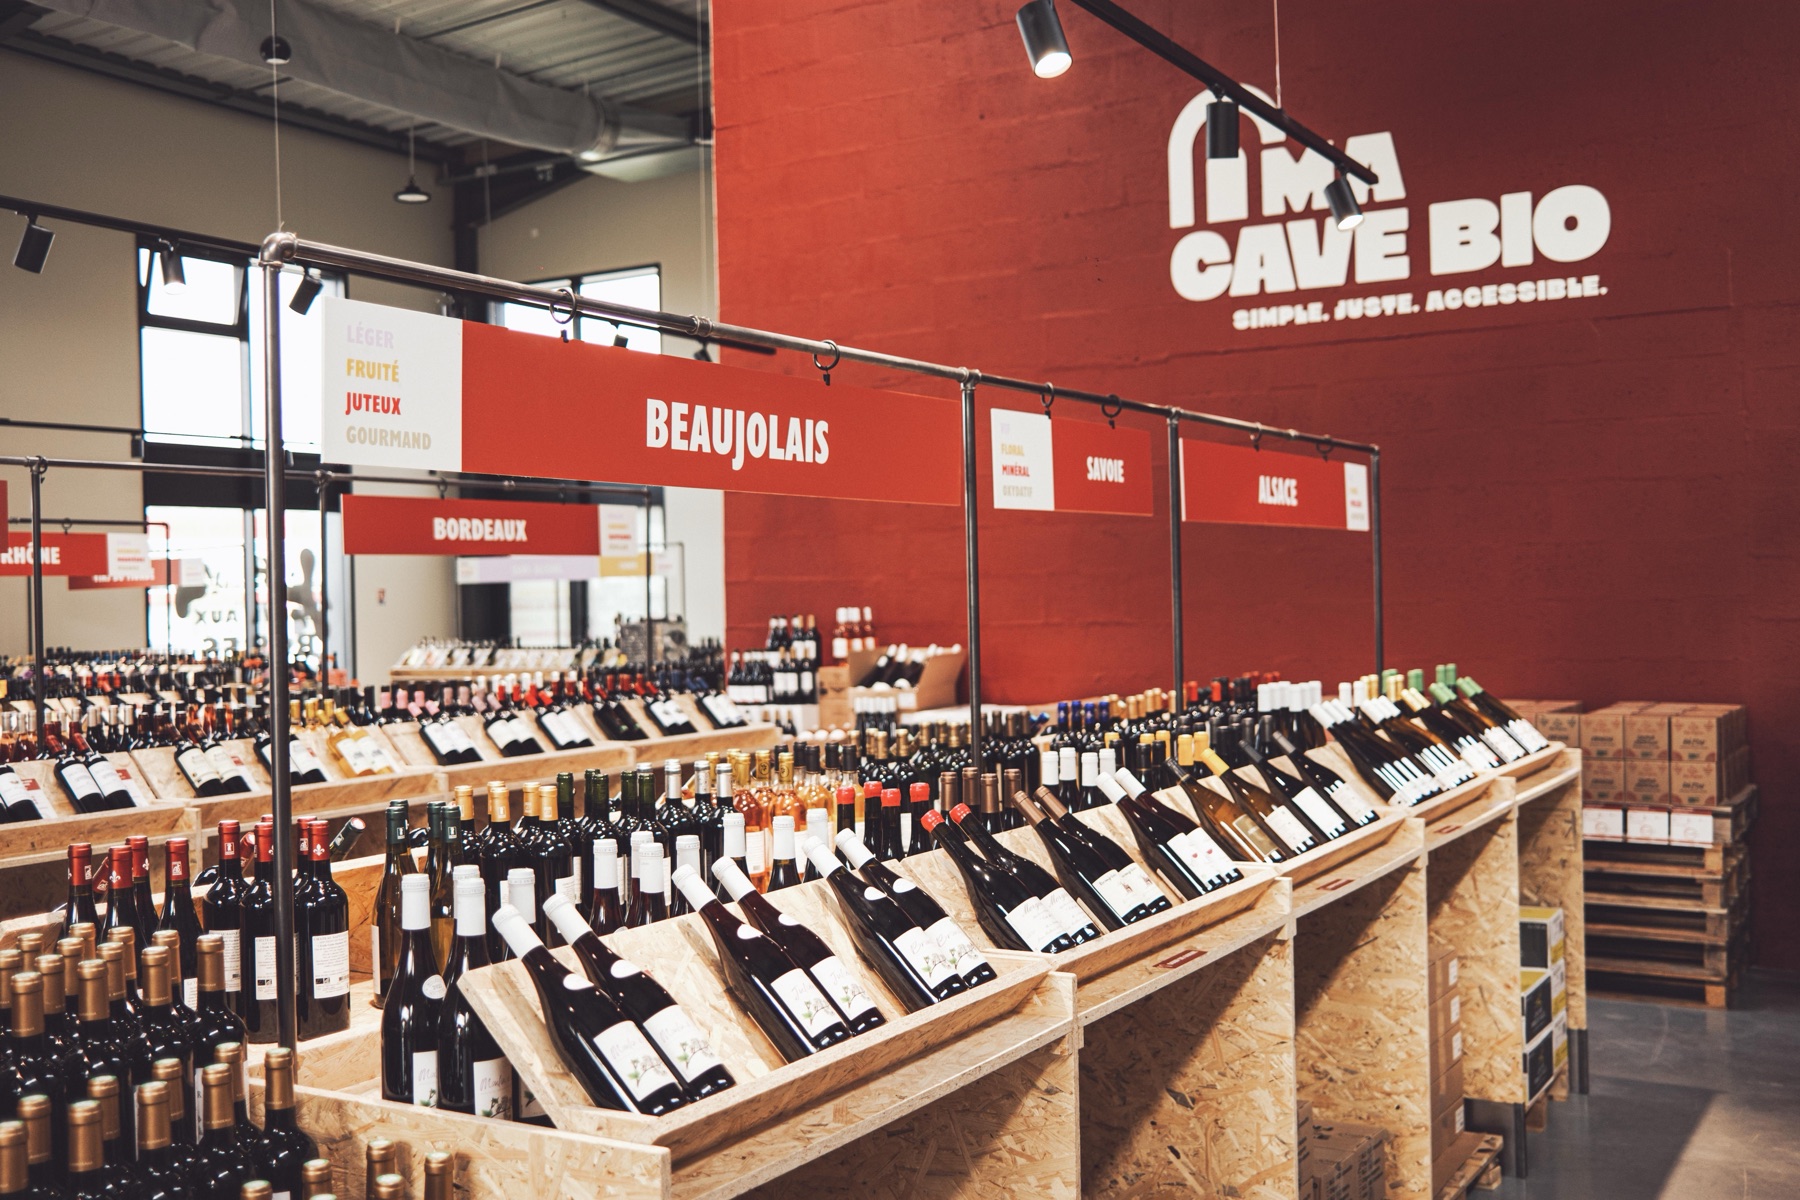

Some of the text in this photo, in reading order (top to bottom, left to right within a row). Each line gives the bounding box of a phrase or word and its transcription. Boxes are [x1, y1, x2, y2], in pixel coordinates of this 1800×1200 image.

[1261, 131, 1406, 217] MA
[1170, 184, 1611, 301] CAVE BIO
[1232, 274, 1608, 330] SIMPLE. JUSTE. ACCESSIBLE.
[347, 322, 395, 350] LÉGER
[346, 358, 400, 383] FRUITÉ
[344, 391, 402, 416] JUTEUX
[346, 425, 432, 451] GOURMAND
[646, 398, 829, 470] BEAUJOLAIS
[1001, 443, 1026, 457] FLORAL
[1001, 461, 1031, 478] MINÉRAL
[1086, 456, 1125, 484] SAVOIE
[1258, 475, 1299, 507] ALSACE
[432, 516, 528, 543] BORDEAUX
